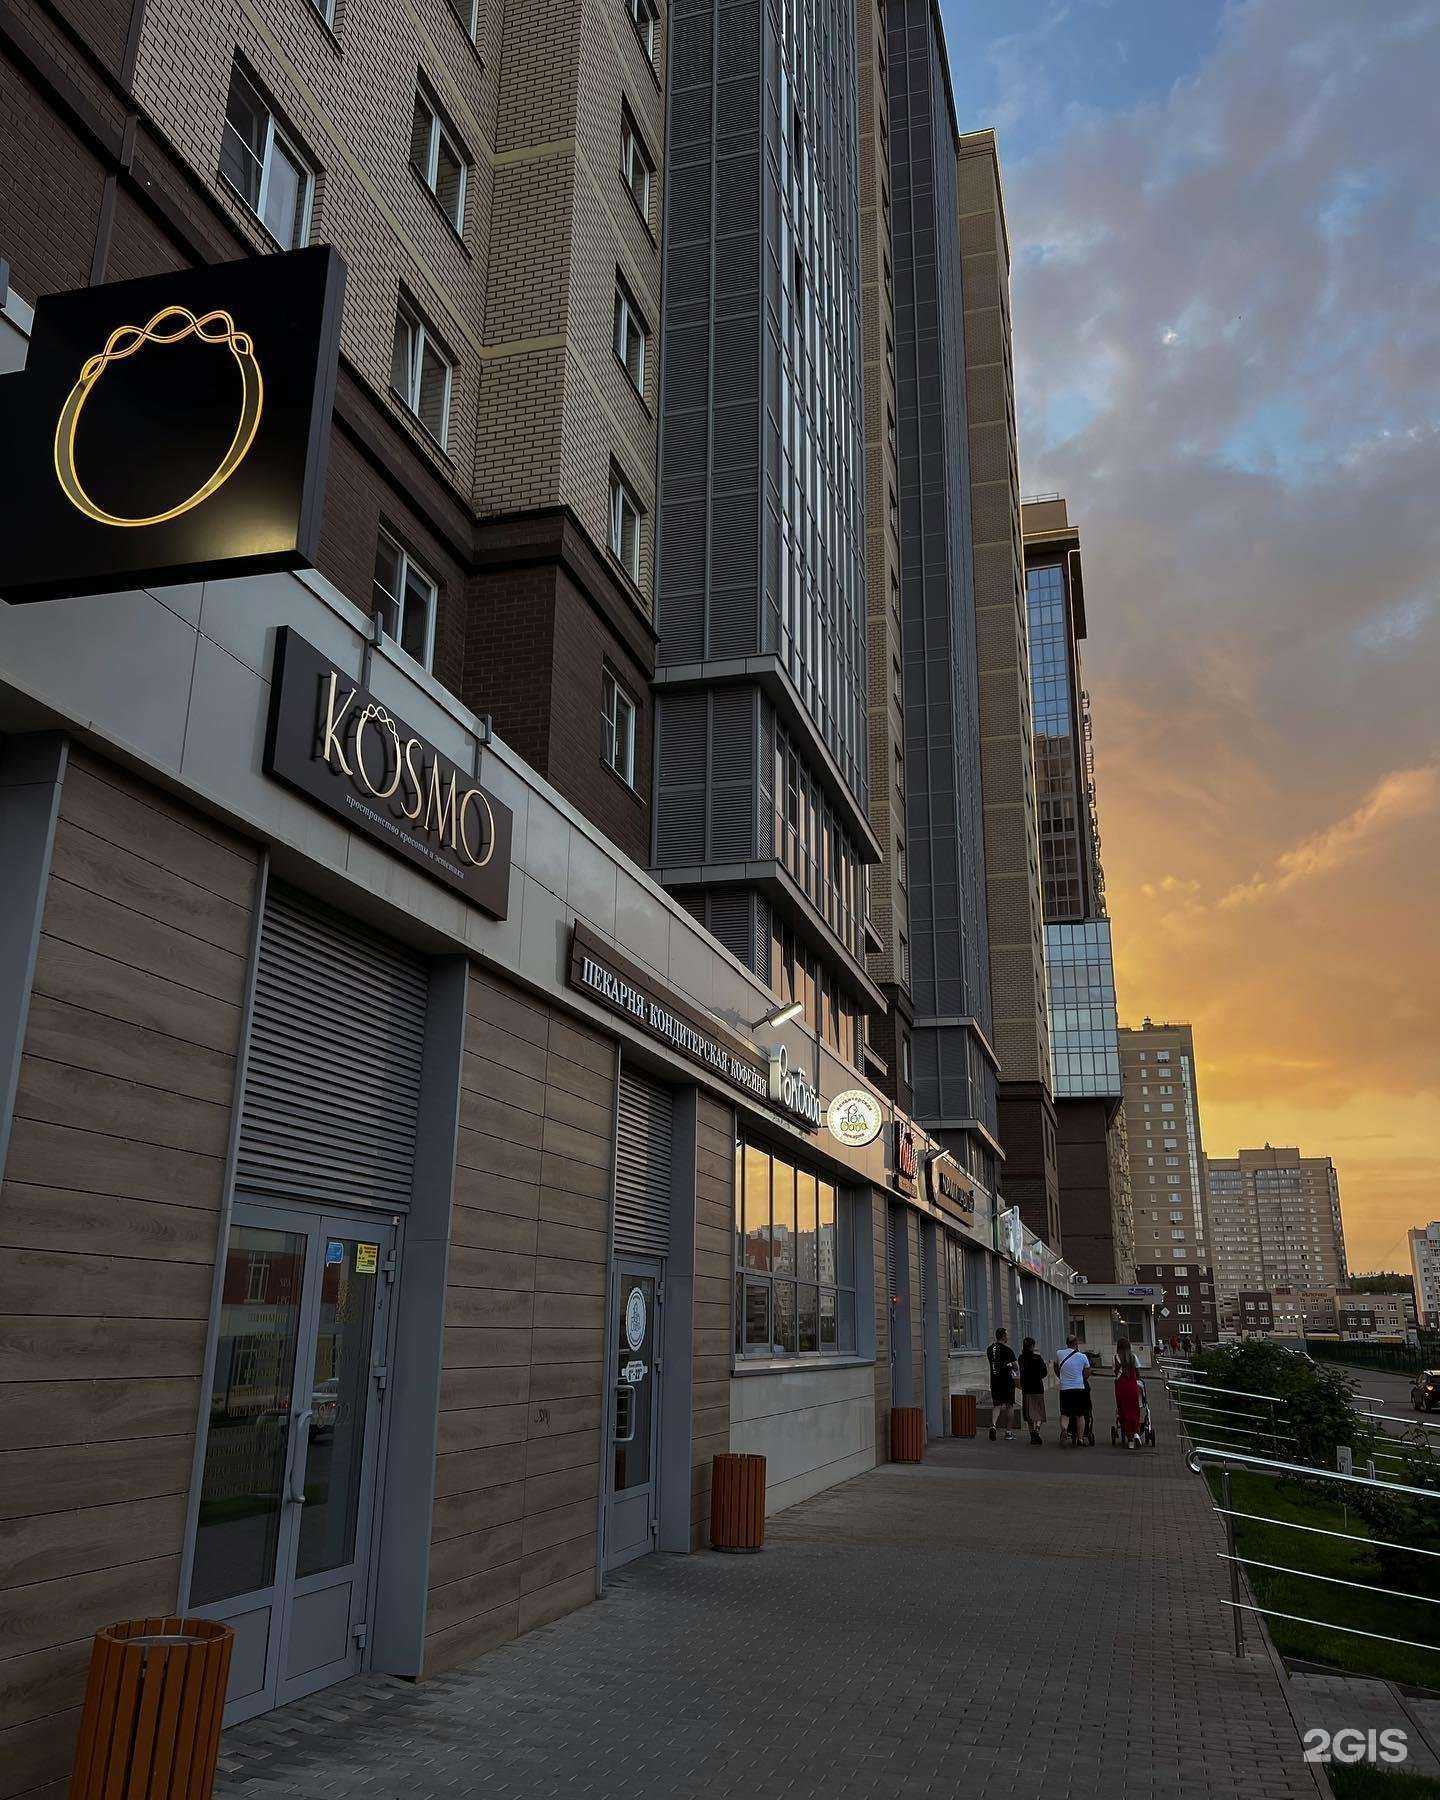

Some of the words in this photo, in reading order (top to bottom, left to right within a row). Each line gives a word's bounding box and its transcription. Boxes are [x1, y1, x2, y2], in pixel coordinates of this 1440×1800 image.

[323, 670, 496, 868] KOSMO
[344, 793, 399, 836] пространство
[400, 831, 429, 856] красоты
[581, 957, 645, 1020] ПЕКАРНЯ
[648, 1002, 728, 1071] КОНДИТЕРСКАЯ
[730, 1057, 768, 1098] КОФЕЙНЯ
